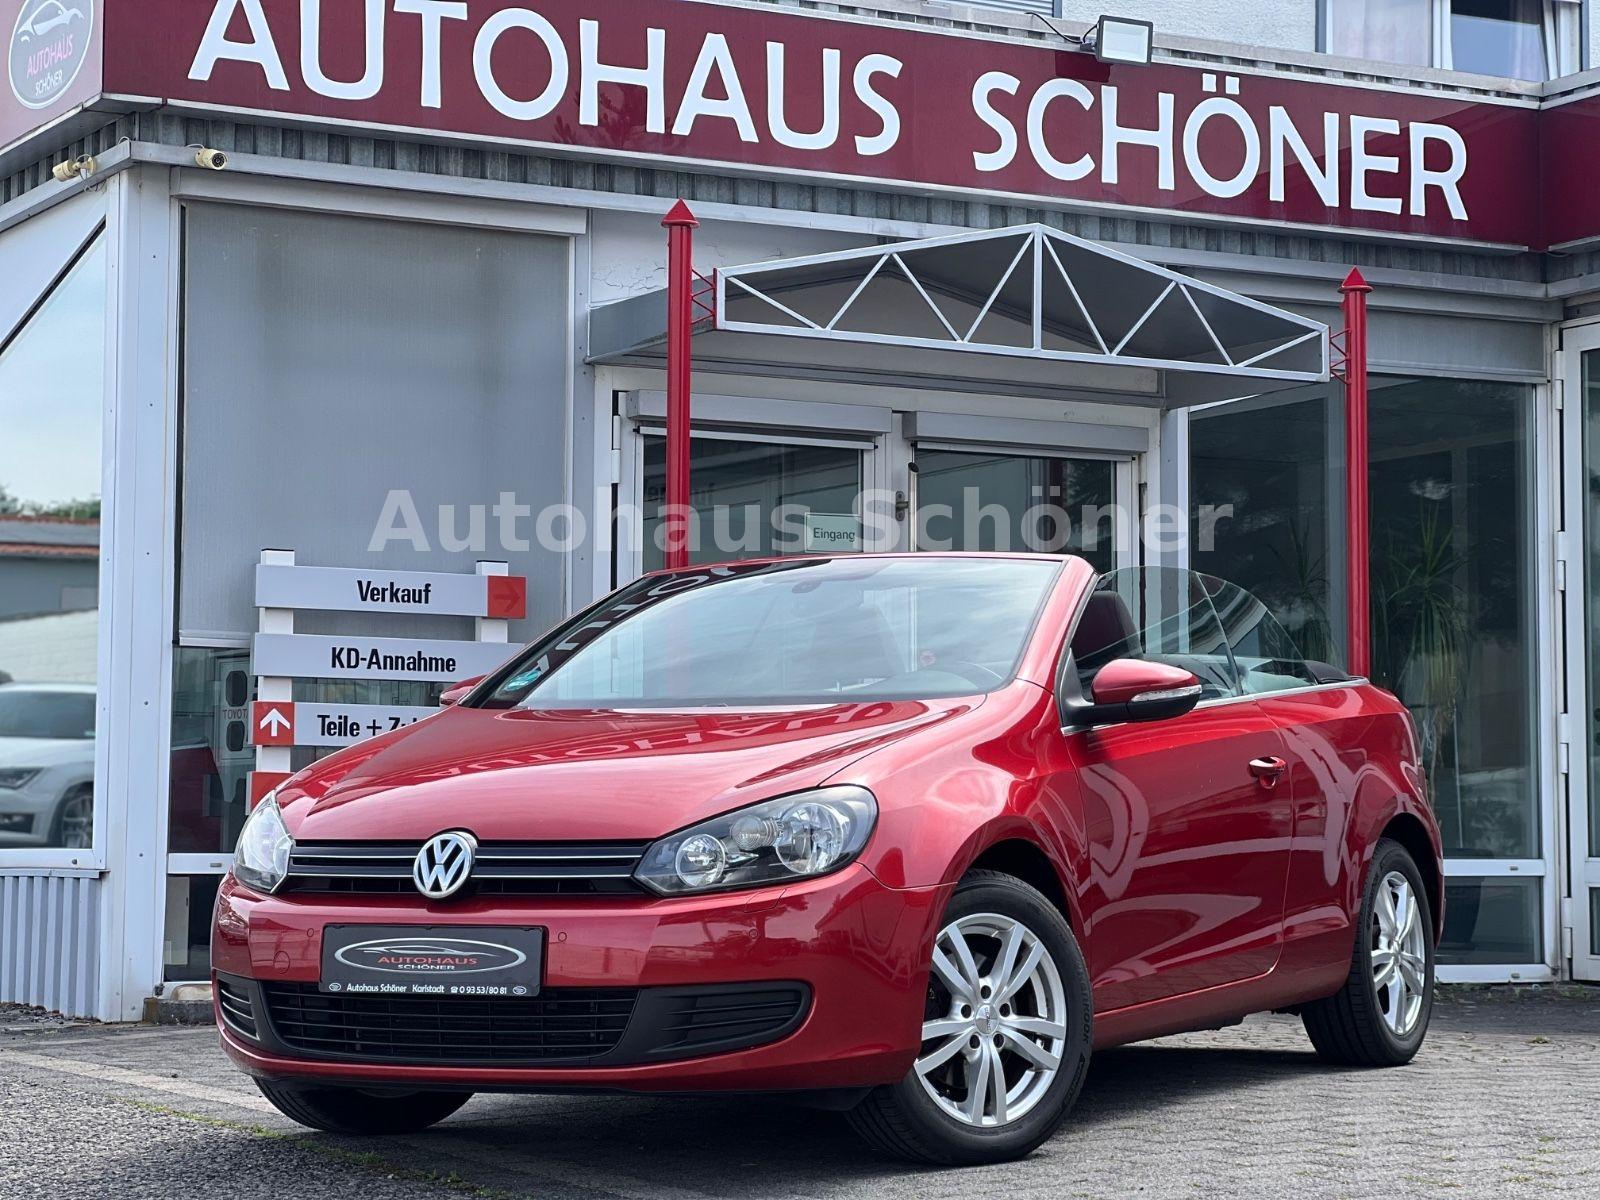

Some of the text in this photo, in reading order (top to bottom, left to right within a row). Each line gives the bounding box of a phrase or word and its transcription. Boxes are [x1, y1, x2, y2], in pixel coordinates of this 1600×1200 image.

[27, 33, 74, 80] AUTOHAUS
[35, 69, 63, 97] SCHÖNER
[187, 0, 1469, 221] AUTOHAUS SCHÖNER
[813, 527, 855, 543] Eingang
[357, 579, 432, 604] Verkauf
[331, 646, 456, 672] KD-Annahme
[223, 708, 249, 719] TOYOT
[317, 714, 361, 737] Teile
[377, 956, 479, 965] AUTOHAUS
[397, 963, 456, 971] SCHÖNER
[346, 982, 379, 992] Autohaus
[380, 983, 407, 993] Schöner
[412, 984, 445, 994] Karlstadt
